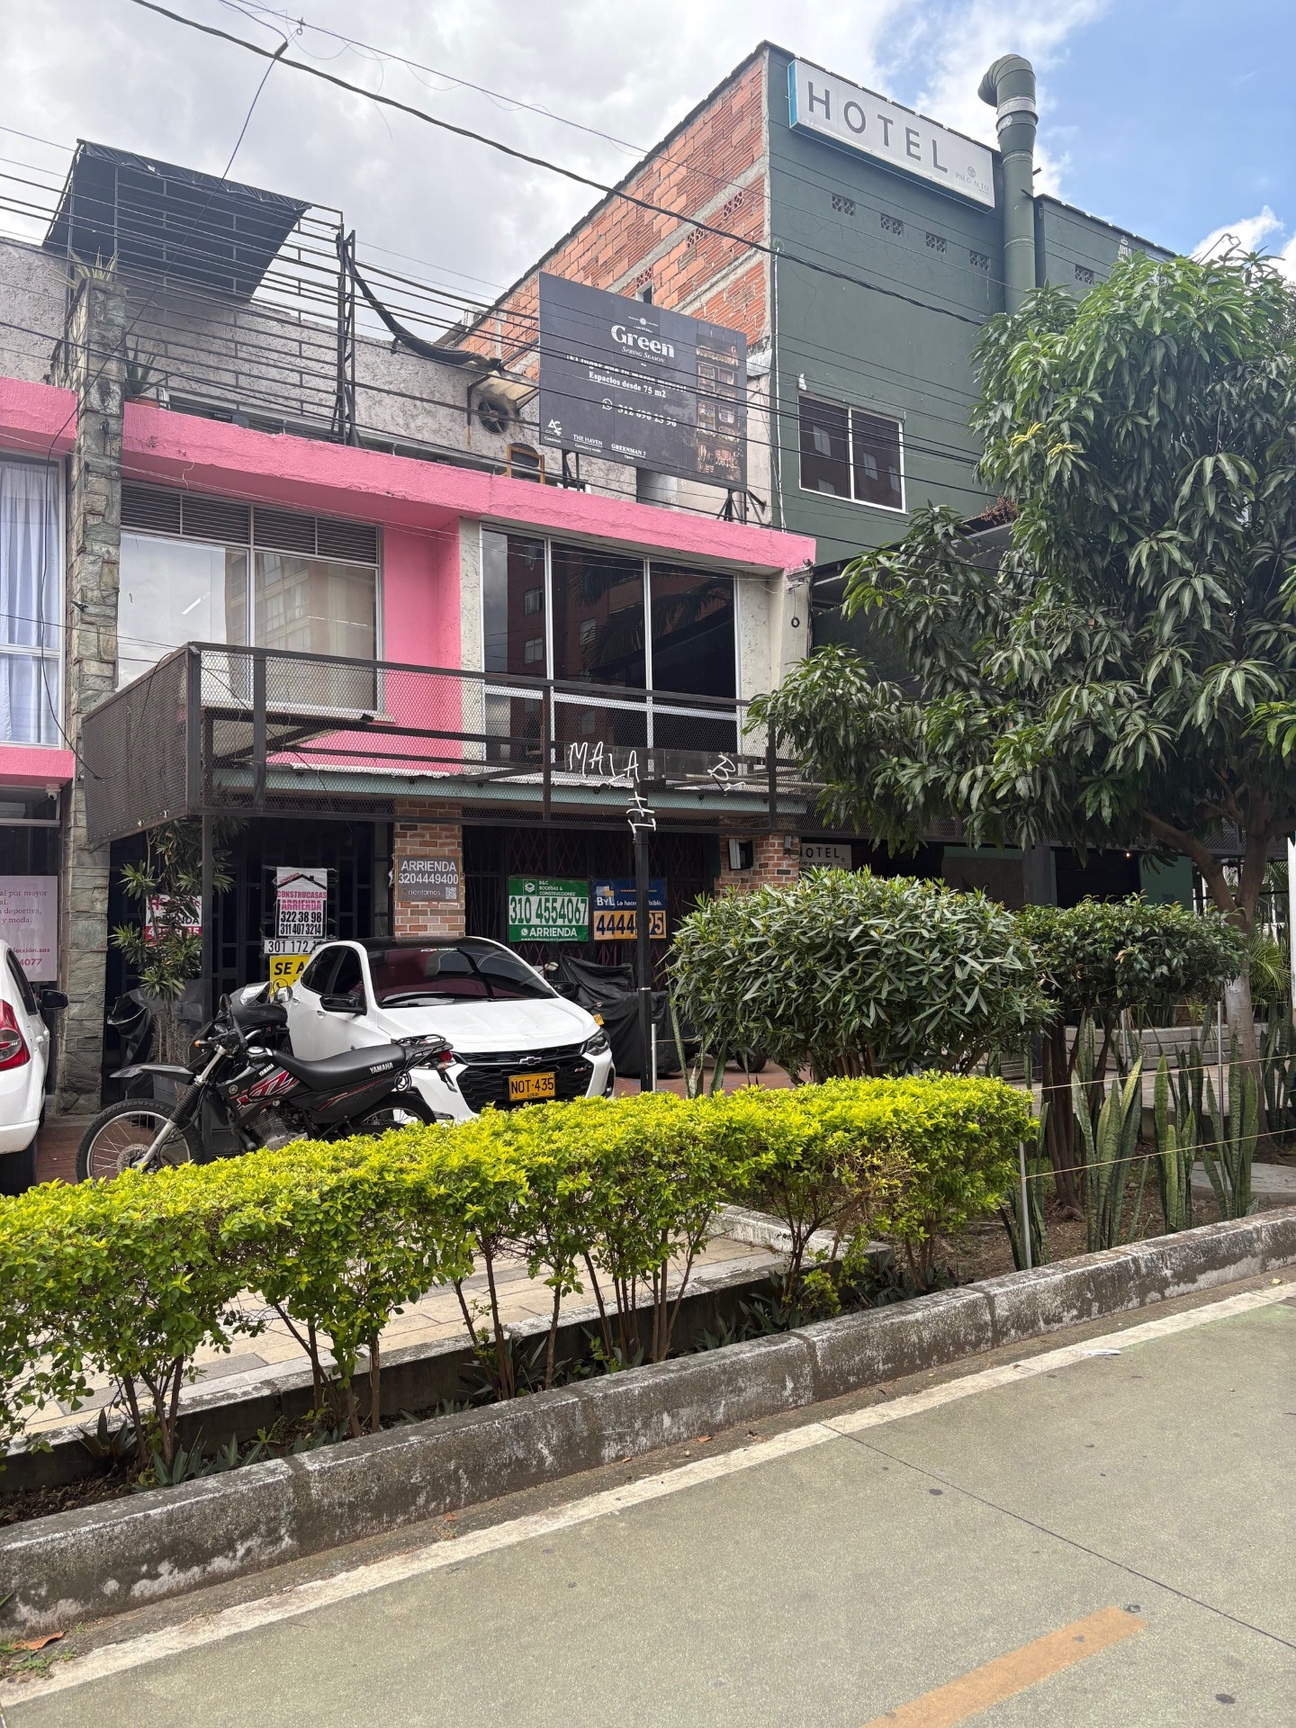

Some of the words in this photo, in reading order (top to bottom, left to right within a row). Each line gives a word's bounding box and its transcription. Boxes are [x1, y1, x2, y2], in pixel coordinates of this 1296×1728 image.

[806, 80, 949, 174] HOTEL
[610, 324, 675, 358] Green
[588, 371, 621, 387] Espacios
[621, 380, 642, 392] desde
[643, 384, 653, 395] 75
[654, 388, 667, 398] m2
[400, 860, 457, 872] ARRIENDA
[398, 873, 459, 884] 3204449400
[276, 890, 327, 899] CONSTRUCASAS
[281, 899, 322, 911] ARRIENDA
[510, 896, 532, 924] 310
[535, 897, 588, 924] 4554067
[280, 911, 297, 923] 322
[298, 911, 309, 923] 38
[311, 911, 322, 923] 98
[280, 923, 291, 935] 311
[292, 923, 305, 935] 407
[305, 923, 322, 935] 3214
[529, 927, 578, 937] ARRIENDA
[268, 940, 286, 953] 301
[291, 940, 309, 953] 172
[274, 962, 293, 975] SE
[258, 1063, 275, 1077] YAMAHA
[369, 1061, 394, 1075] YAMAHA
